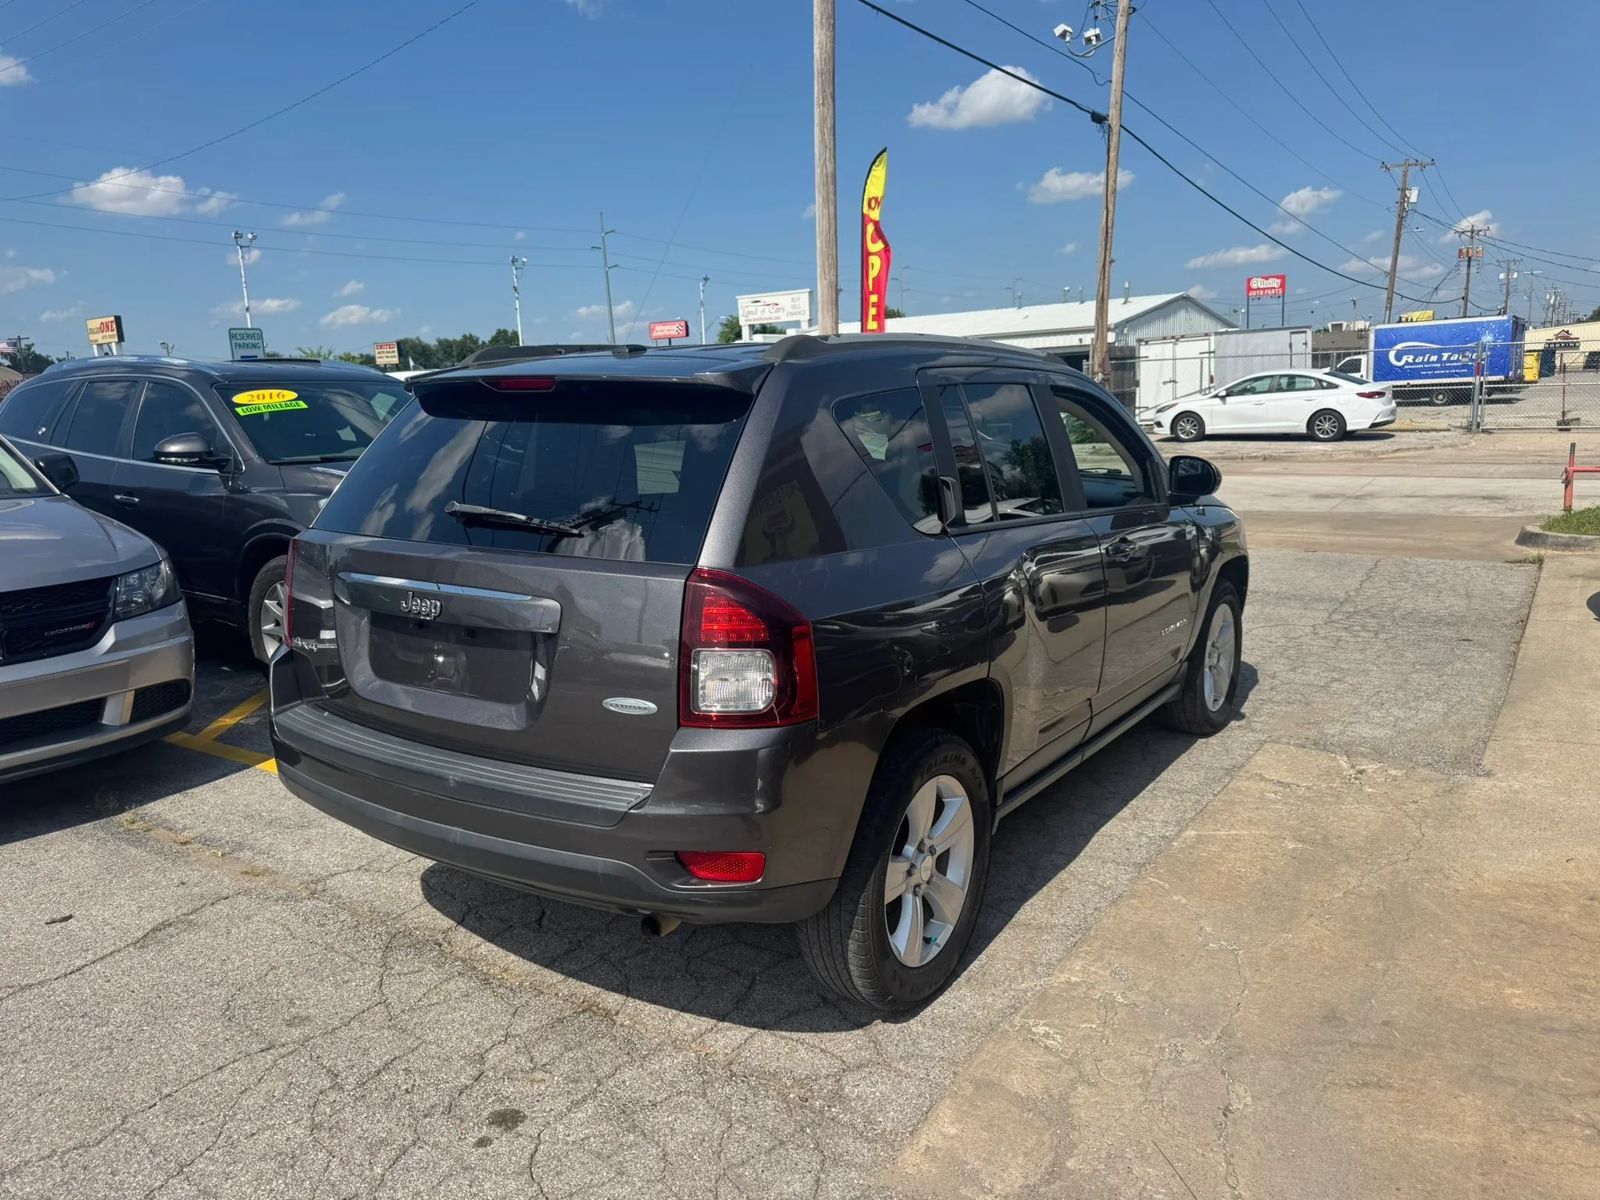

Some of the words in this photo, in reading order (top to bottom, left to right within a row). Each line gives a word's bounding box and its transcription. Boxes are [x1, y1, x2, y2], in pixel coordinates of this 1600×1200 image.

[100, 320, 116, 334] ONE
[231, 333, 261, 341] RESERVED
[234, 342, 261, 350] PARKING
[247, 392, 286, 402] 2016
[241, 406, 261, 414] LOW
[263, 401, 301, 411] MILEAGE
[400, 591, 442, 620] Jeep
